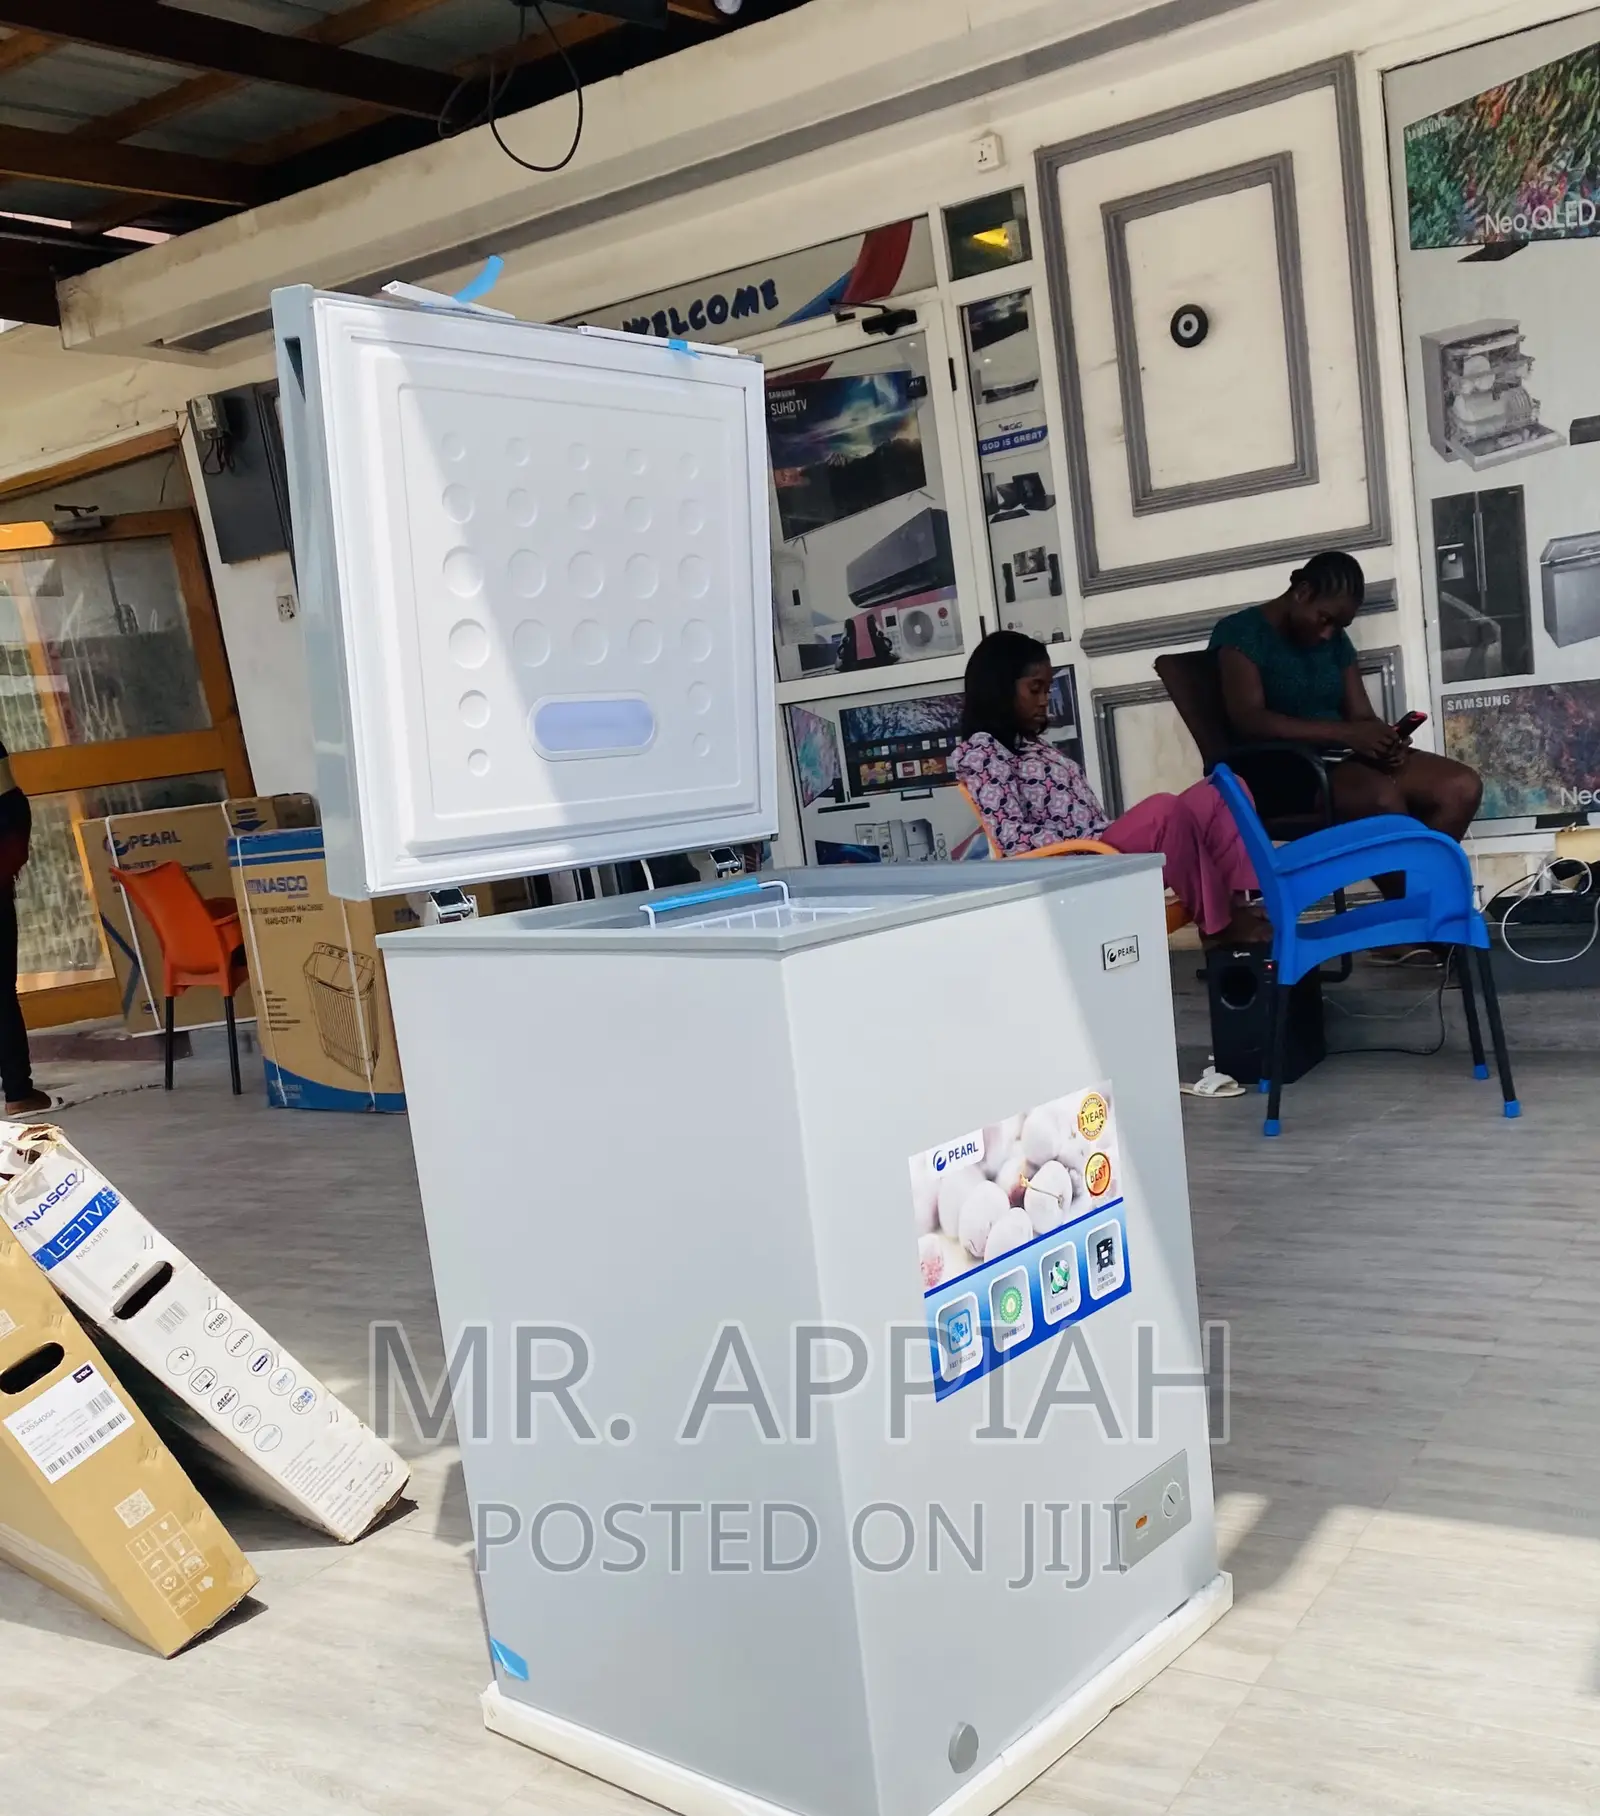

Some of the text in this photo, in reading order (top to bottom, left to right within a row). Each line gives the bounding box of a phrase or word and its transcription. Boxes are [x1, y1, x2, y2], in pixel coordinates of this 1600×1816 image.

[1484, 198, 1596, 235] Neo QLED
[622, 278, 779, 338] WELCOME
[982, 430, 1043, 451] GOD IS GREAT
[1447, 694, 1511, 711] SAMSUNG
[129, 830, 182, 849] PEARL
[256, 875, 308, 894] NASCO
[1117, 946, 1137, 958] PEARL
[948, 1141, 979, 1163] PEARL
[1090, 1165, 1106, 1183] BEST
[24, 1172, 77, 1226] NASCO
[78, 1200, 103, 1226] TV
[178, 1350, 190, 1361] TV
[75, 1366, 93, 1381] TCL
